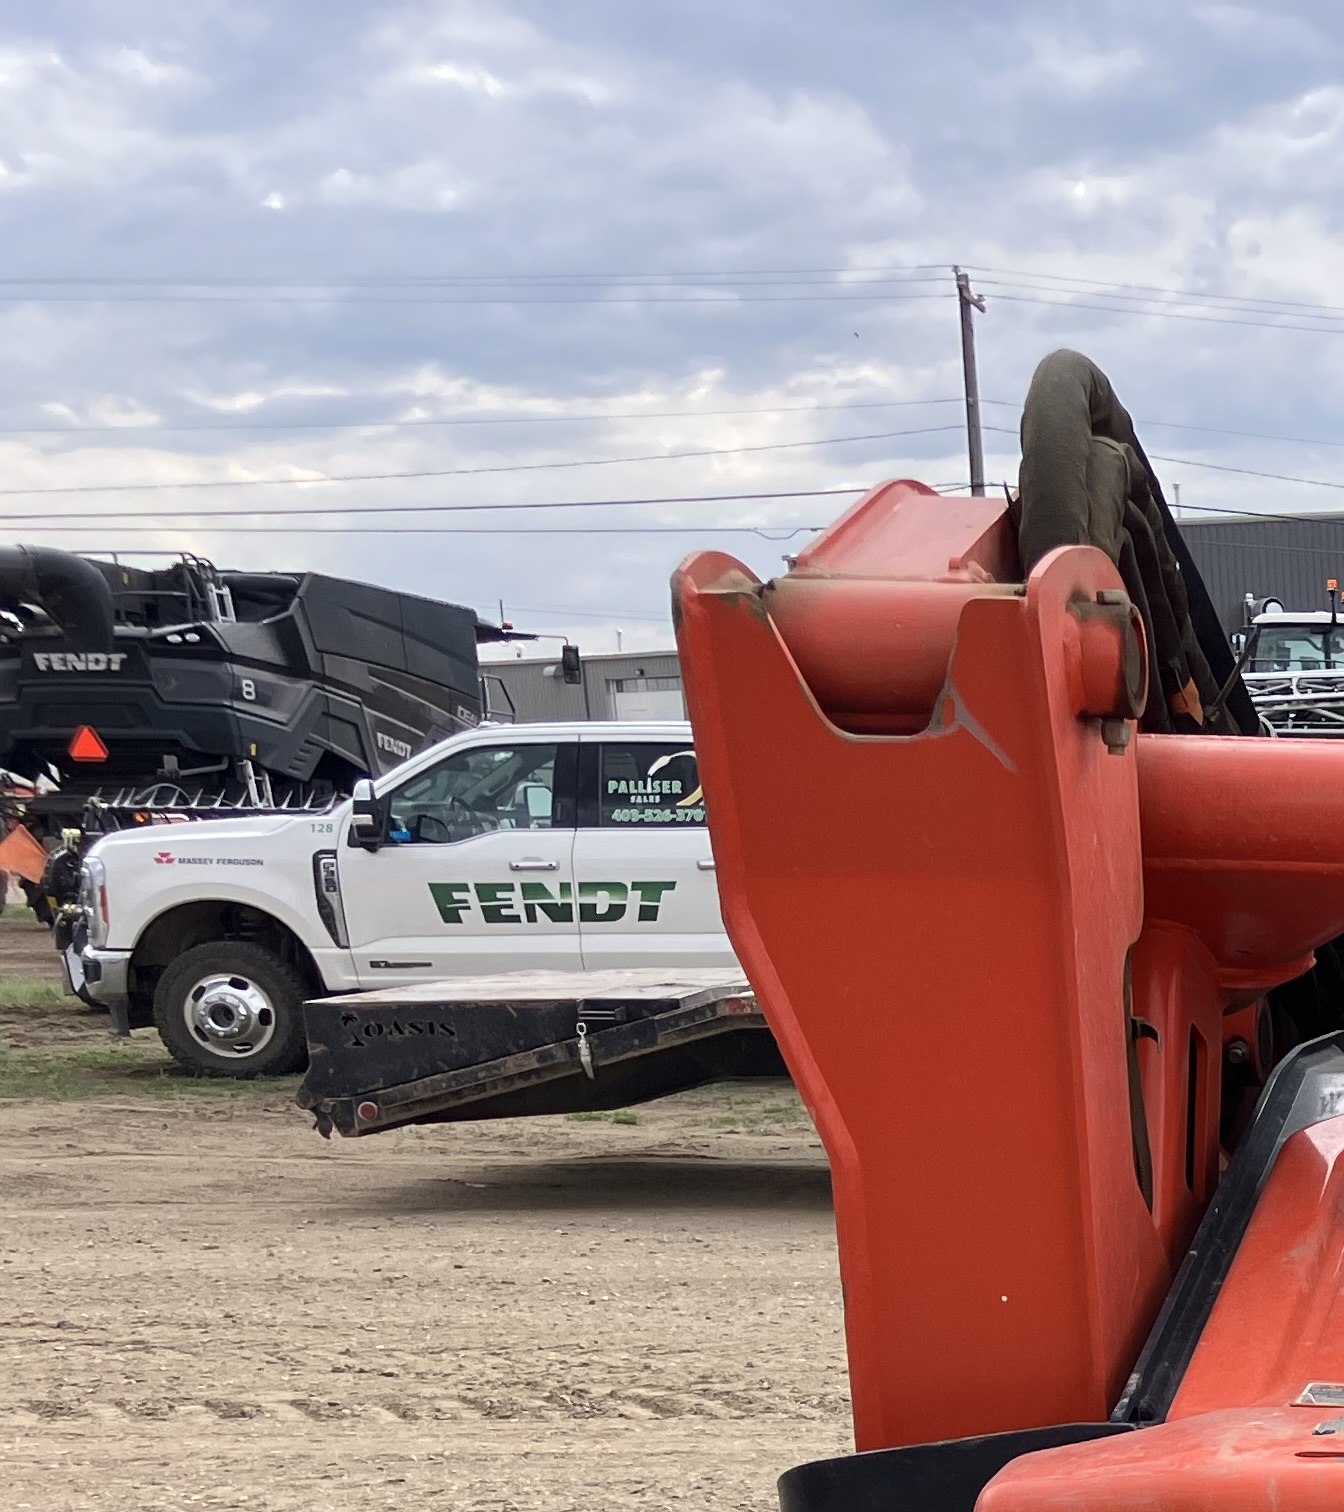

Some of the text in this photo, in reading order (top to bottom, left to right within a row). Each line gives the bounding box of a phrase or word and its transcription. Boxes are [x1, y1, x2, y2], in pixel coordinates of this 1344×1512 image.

[33, 652, 127, 671] FENDT
[241, 679, 256, 700] 8
[377, 732, 412, 759] FENDT
[608, 779, 682, 794] PALLISER
[611, 808, 706, 823] 403-526-370
[310, 823, 334, 833] 128
[178, 857, 264, 867] MASSEY FERGUSON
[427, 880, 677, 924] FENDT
[363, 1020, 456, 1037] OASIS
